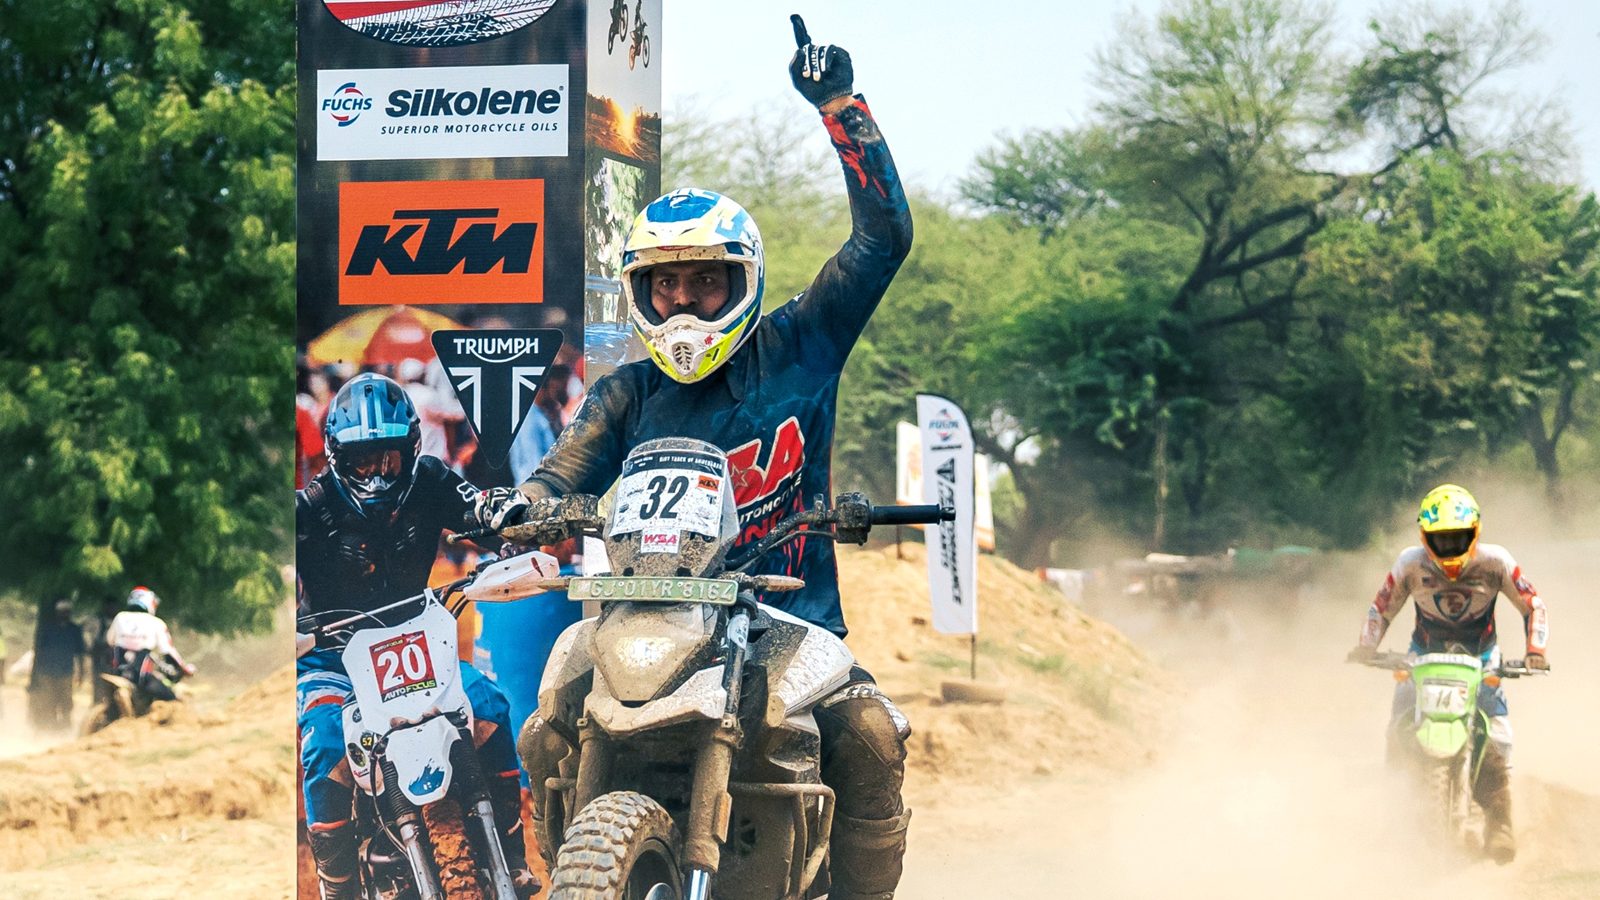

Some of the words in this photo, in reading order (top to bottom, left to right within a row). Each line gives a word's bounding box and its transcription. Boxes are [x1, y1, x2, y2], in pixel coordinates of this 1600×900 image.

[322, 98, 372, 111] FUCHS
[385, 87, 561, 117] Silkolene
[381, 125, 438, 135] SUPERIOR
[445, 123, 525, 133] MOTORCYCLE
[531, 122, 558, 131] OILS
[345, 208, 537, 275] KTM
[453, 337, 539, 360] TRIUMPH
[640, 475, 689, 520] 32
[644, 533, 677, 544] WSA
[377, 644, 426, 690] 20
